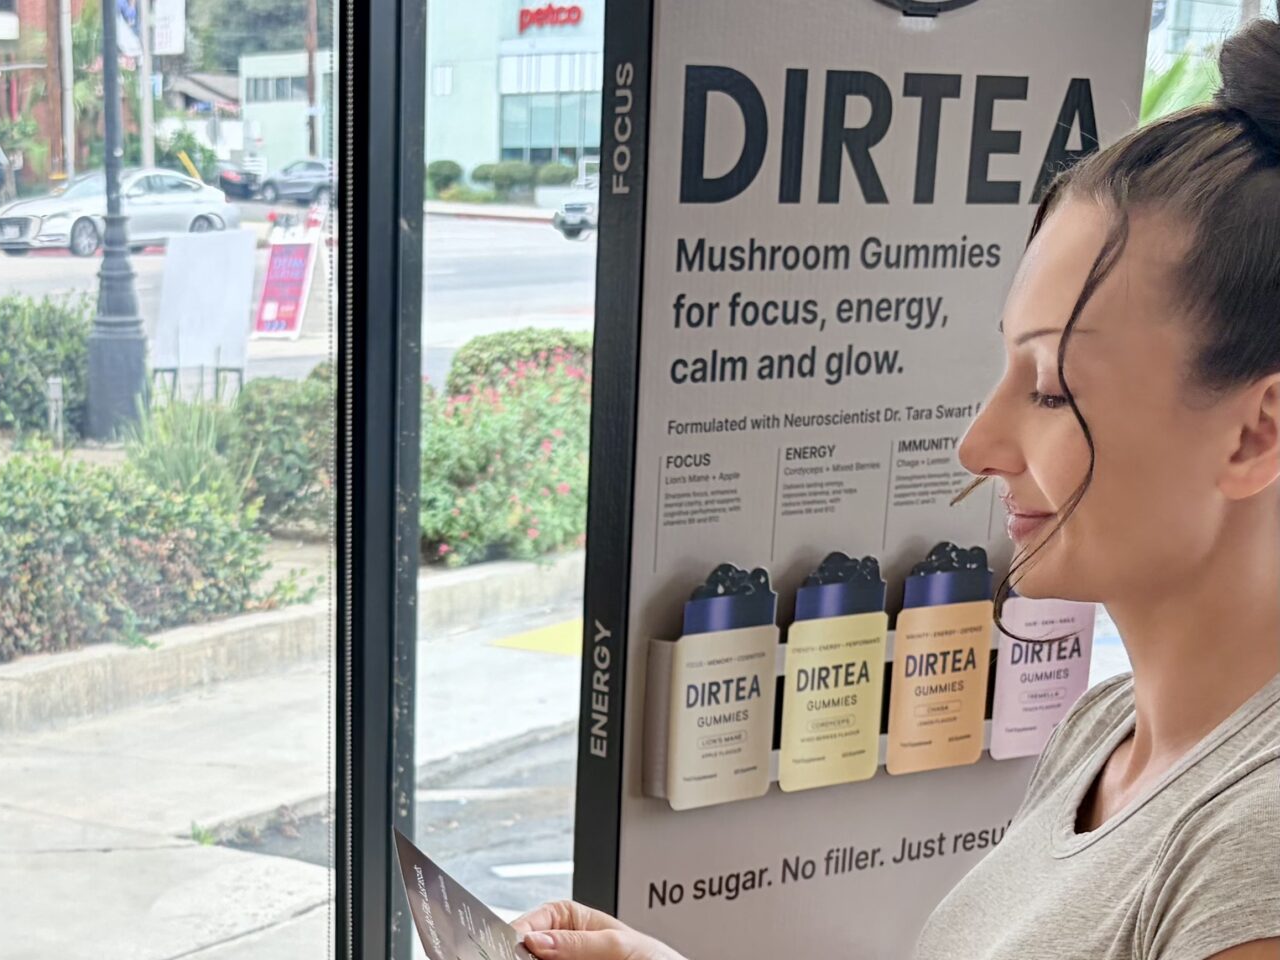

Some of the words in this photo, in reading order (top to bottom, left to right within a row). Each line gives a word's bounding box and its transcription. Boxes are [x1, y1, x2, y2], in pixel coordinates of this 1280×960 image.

[518, 4, 583, 34] petco
[612, 62, 634, 195] FOCUS
[678, 64, 1101, 205] DIRTEA
[675, 237, 850, 273] Mushroom
[860, 236, 1001, 271] Gummies
[672, 294, 720, 329] for
[728, 292, 828, 332] focus,
[836, 292, 949, 331] energy,
[670, 349, 748, 384] calm
[757, 345, 816, 381] and
[825, 345, 905, 385] glow.
[667, 416, 748, 436] Formulated
[750, 412, 780, 431] with
[784, 408, 882, 429] Neuroscientist
[884, 407, 902, 423] Dr.
[905, 406, 933, 422] Tara
[936, 403, 972, 421] Swart
[785, 444, 836, 460] ENERGY
[898, 436, 959, 453] IMMUNITY
[666, 453, 711, 469] FOCUS
[905, 647, 977, 679] DIRTEA
[1010, 637, 1082, 666] DIRTEA
[589, 618, 613, 758] ENERGY
[686, 674, 761, 709] DIRTEA
[796, 660, 870, 692] DIRTEA
[914, 680, 965, 697] GUMMIES
[1020, 668, 1070, 684] GUMMIES
[697, 709, 749, 728] GUMMIES
[806, 694, 858, 711] GUMMIES
[648, 877, 684, 909] No
[692, 867, 773, 903] sugar.
[781, 854, 816, 884] No
[823, 843, 885, 876] filler.
[893, 833, 946, 864] Just
